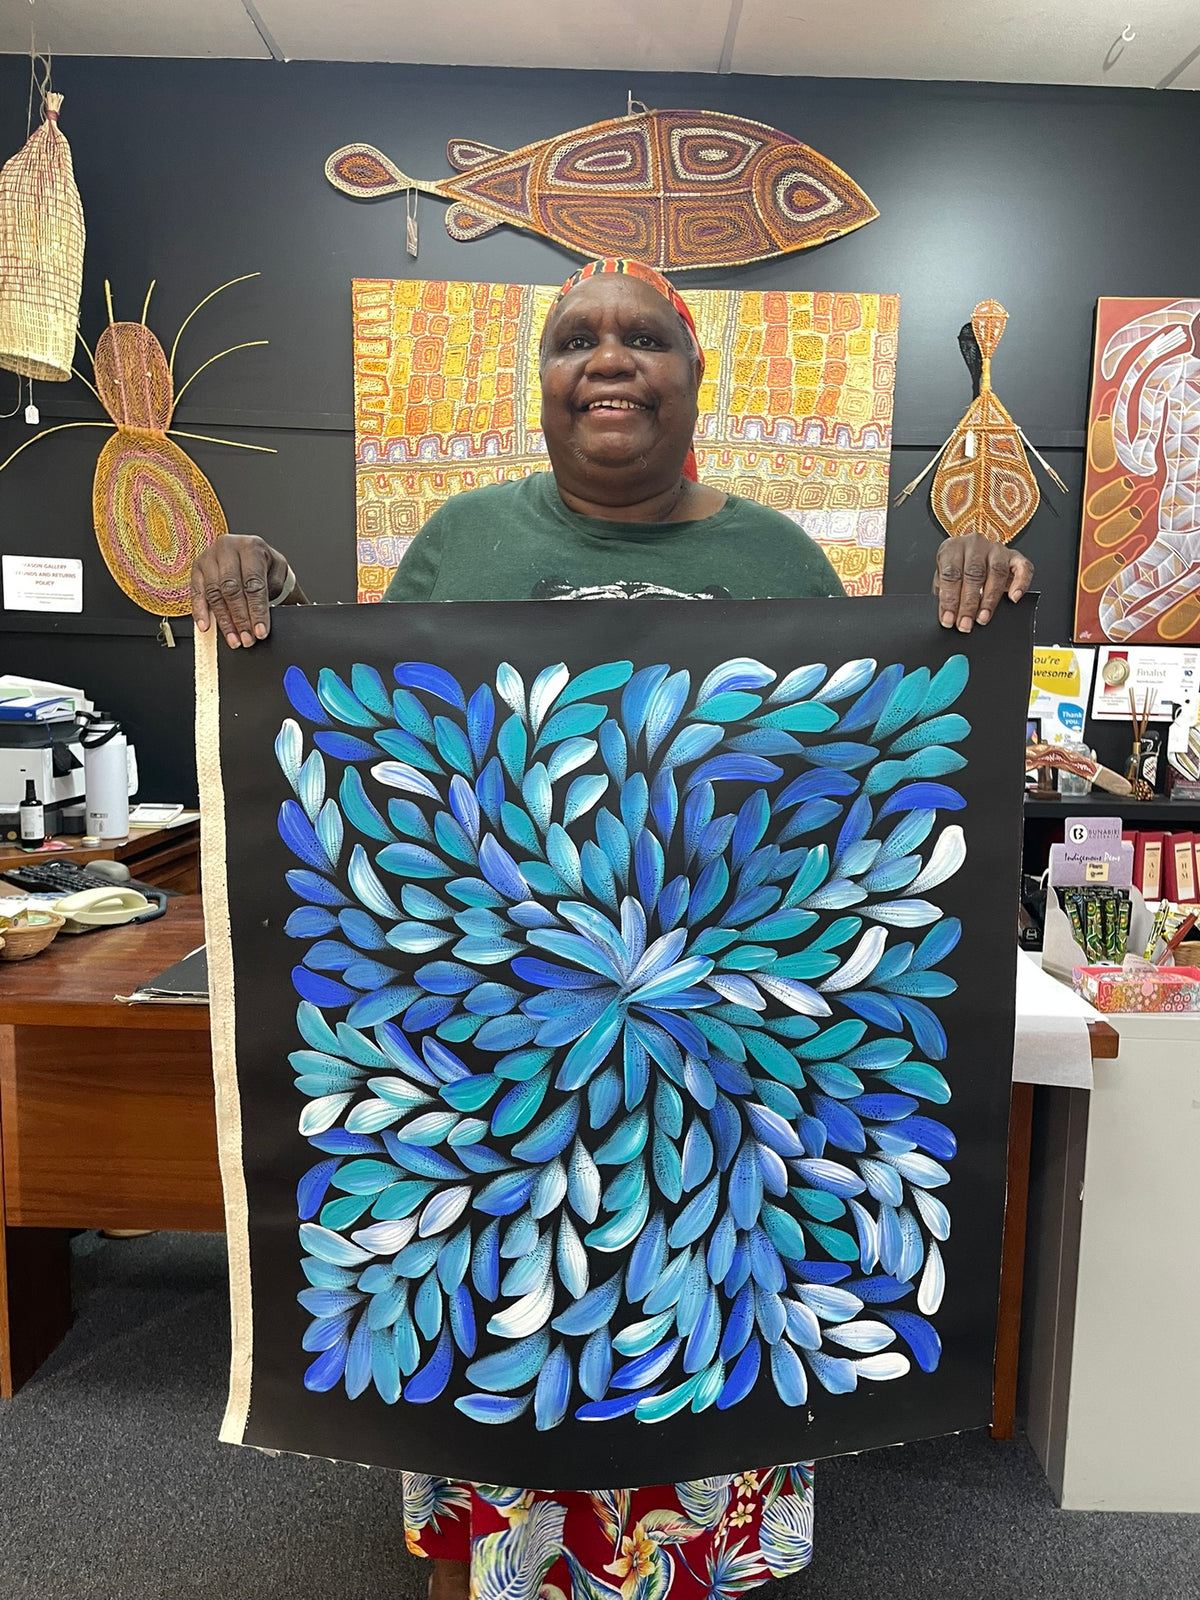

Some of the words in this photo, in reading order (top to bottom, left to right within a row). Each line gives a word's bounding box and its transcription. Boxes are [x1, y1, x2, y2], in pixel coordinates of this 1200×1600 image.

[1033, 655, 1061, 666] ou're
[1033, 670, 1074, 679] wesome
[1136, 668, 1167, 677] Finalist
[1064, 852, 1102, 864] Indigenous
[1103, 851, 1121, 862] Pens
